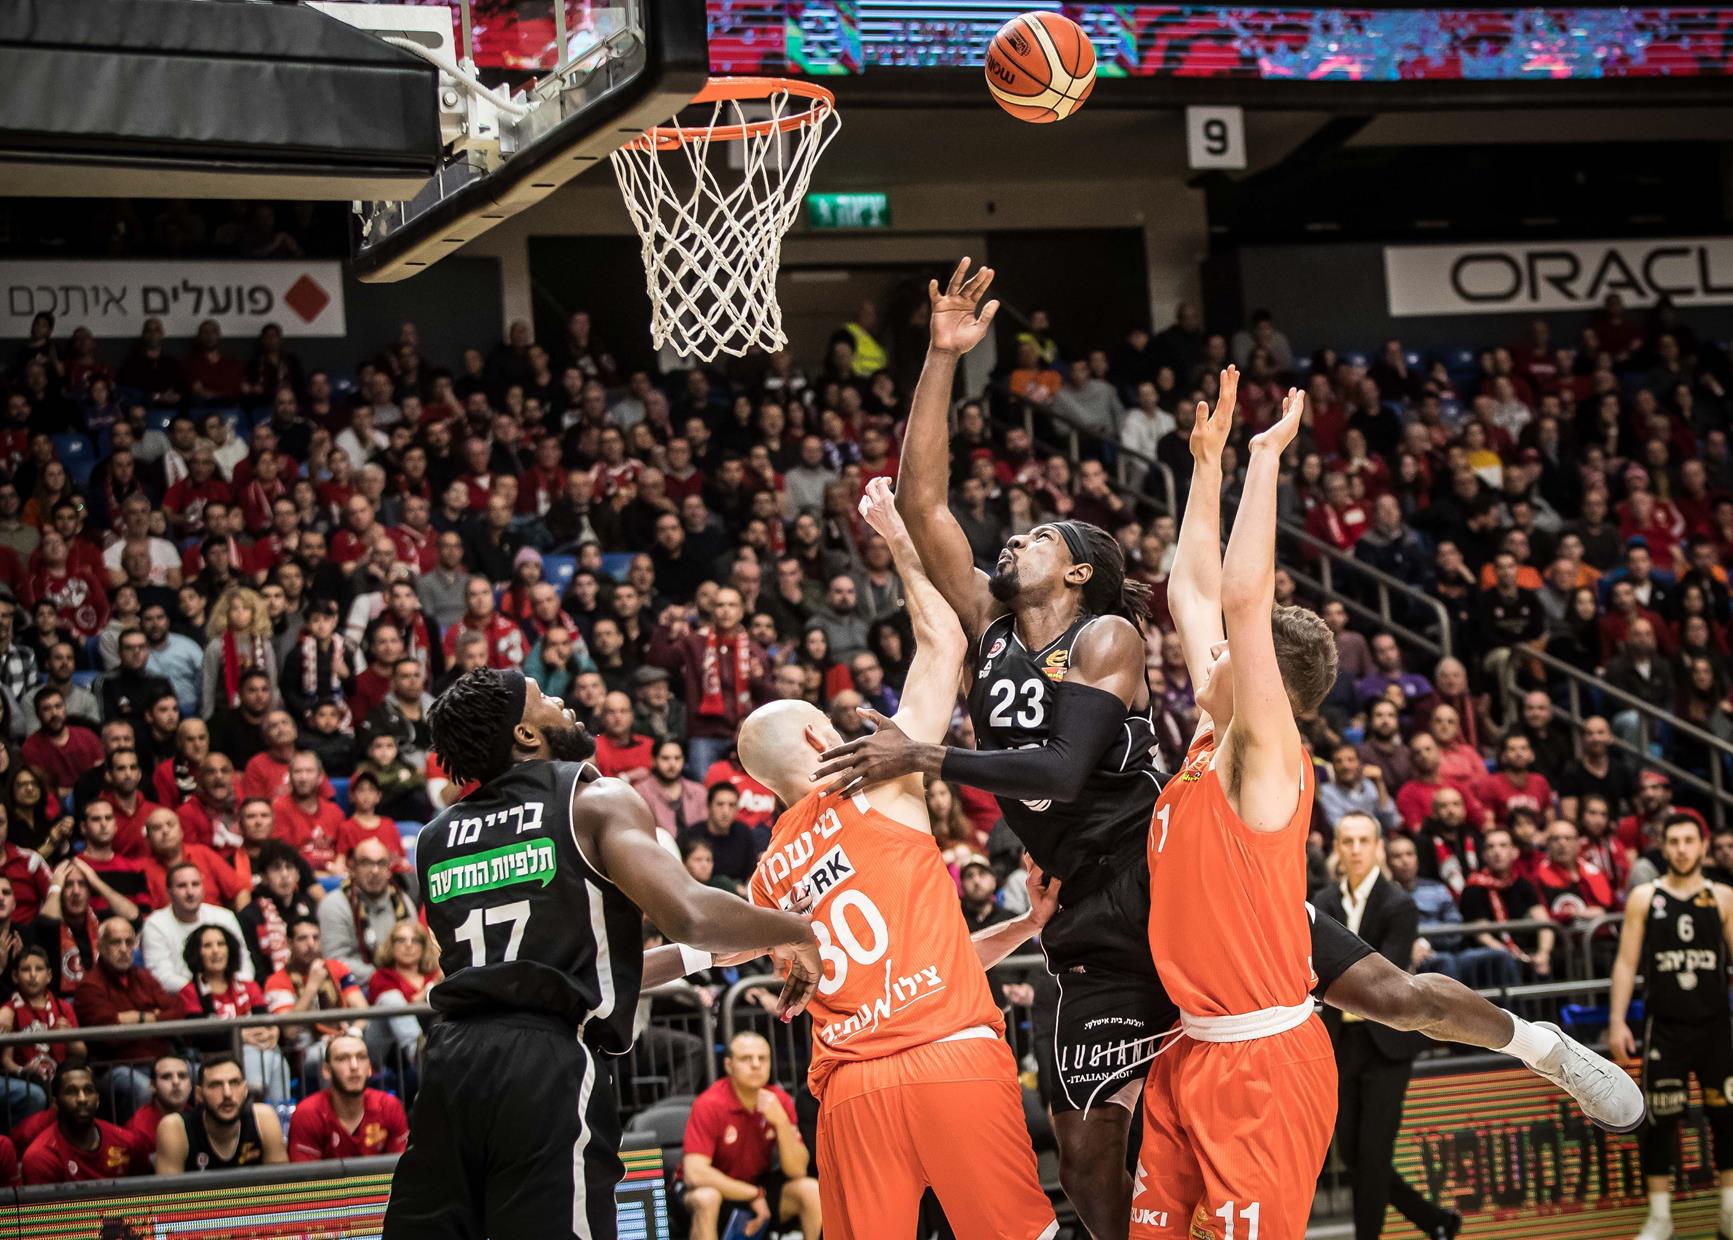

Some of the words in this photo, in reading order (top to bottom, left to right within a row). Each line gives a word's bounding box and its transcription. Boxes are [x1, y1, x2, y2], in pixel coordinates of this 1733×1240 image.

[1203, 118, 1228, 156] 9
[8, 284, 129, 317] איתכם
[142, 279, 275, 316] פועלים
[989, 678, 1045, 728] 23
[446, 802, 544, 848] בריימו
[490, 844, 554, 883] תלפיות
[760, 807, 843, 896] טישמן
[430, 860, 488, 898] החדשה
[454, 899, 531, 968] 17
[811, 889, 889, 995] 30
[1677, 913, 1695, 943] 6
[1215, 1200, 1260, 1240] 11
